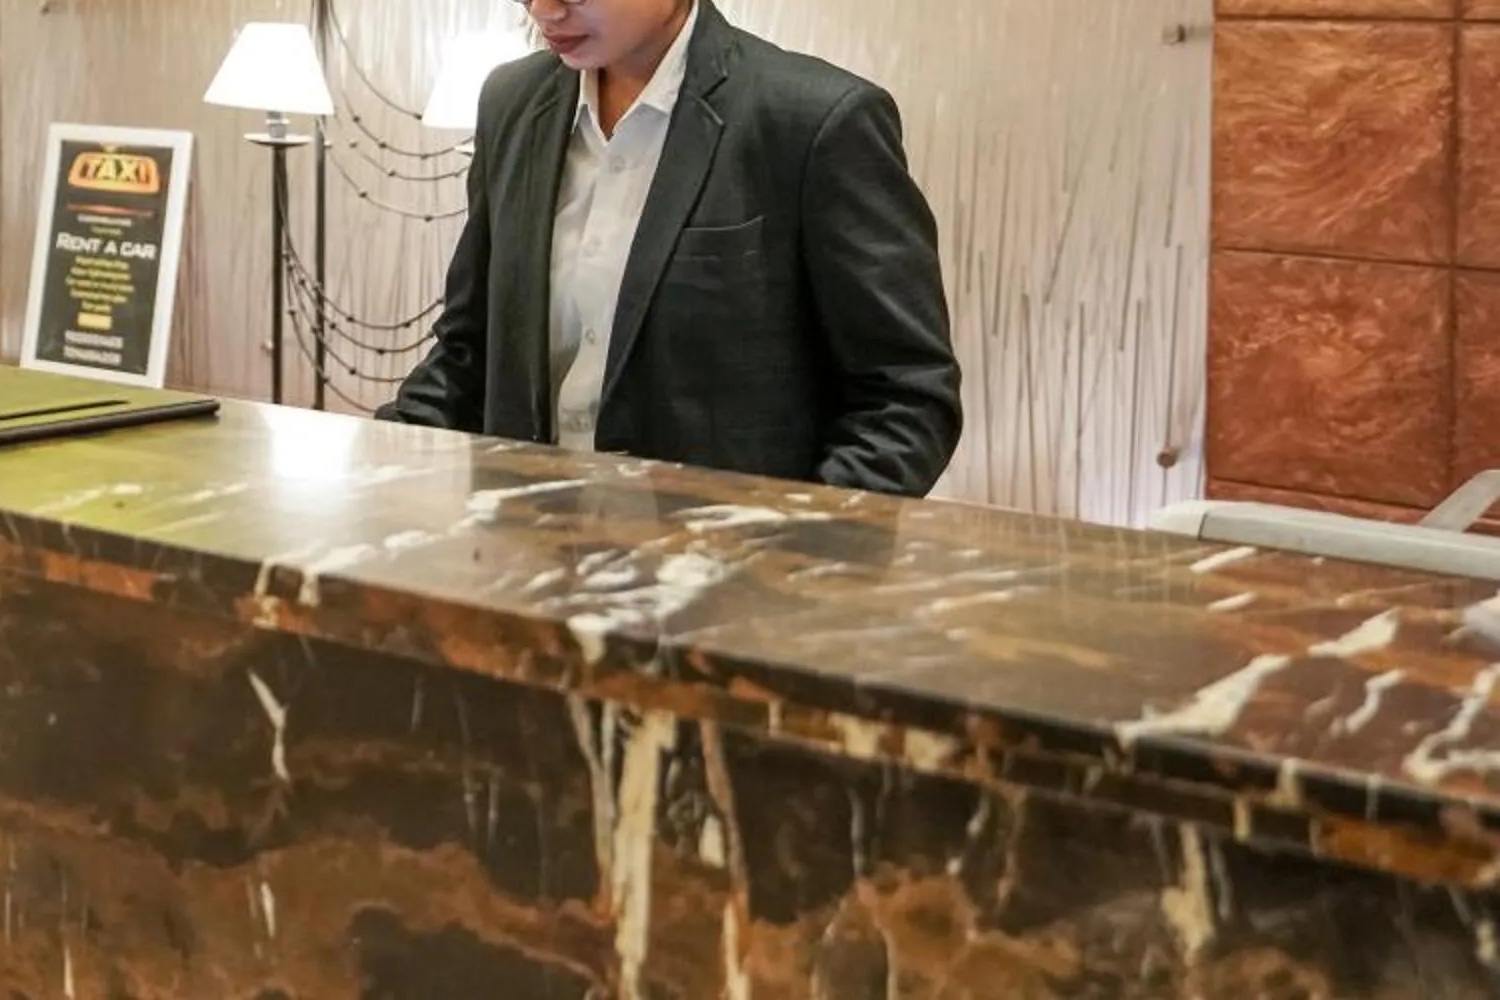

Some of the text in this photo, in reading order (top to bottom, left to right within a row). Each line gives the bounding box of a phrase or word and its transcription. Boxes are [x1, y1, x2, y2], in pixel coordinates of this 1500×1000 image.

[80, 156, 150, 185] TAXI
[56, 232, 158, 260] RENT A CAR
